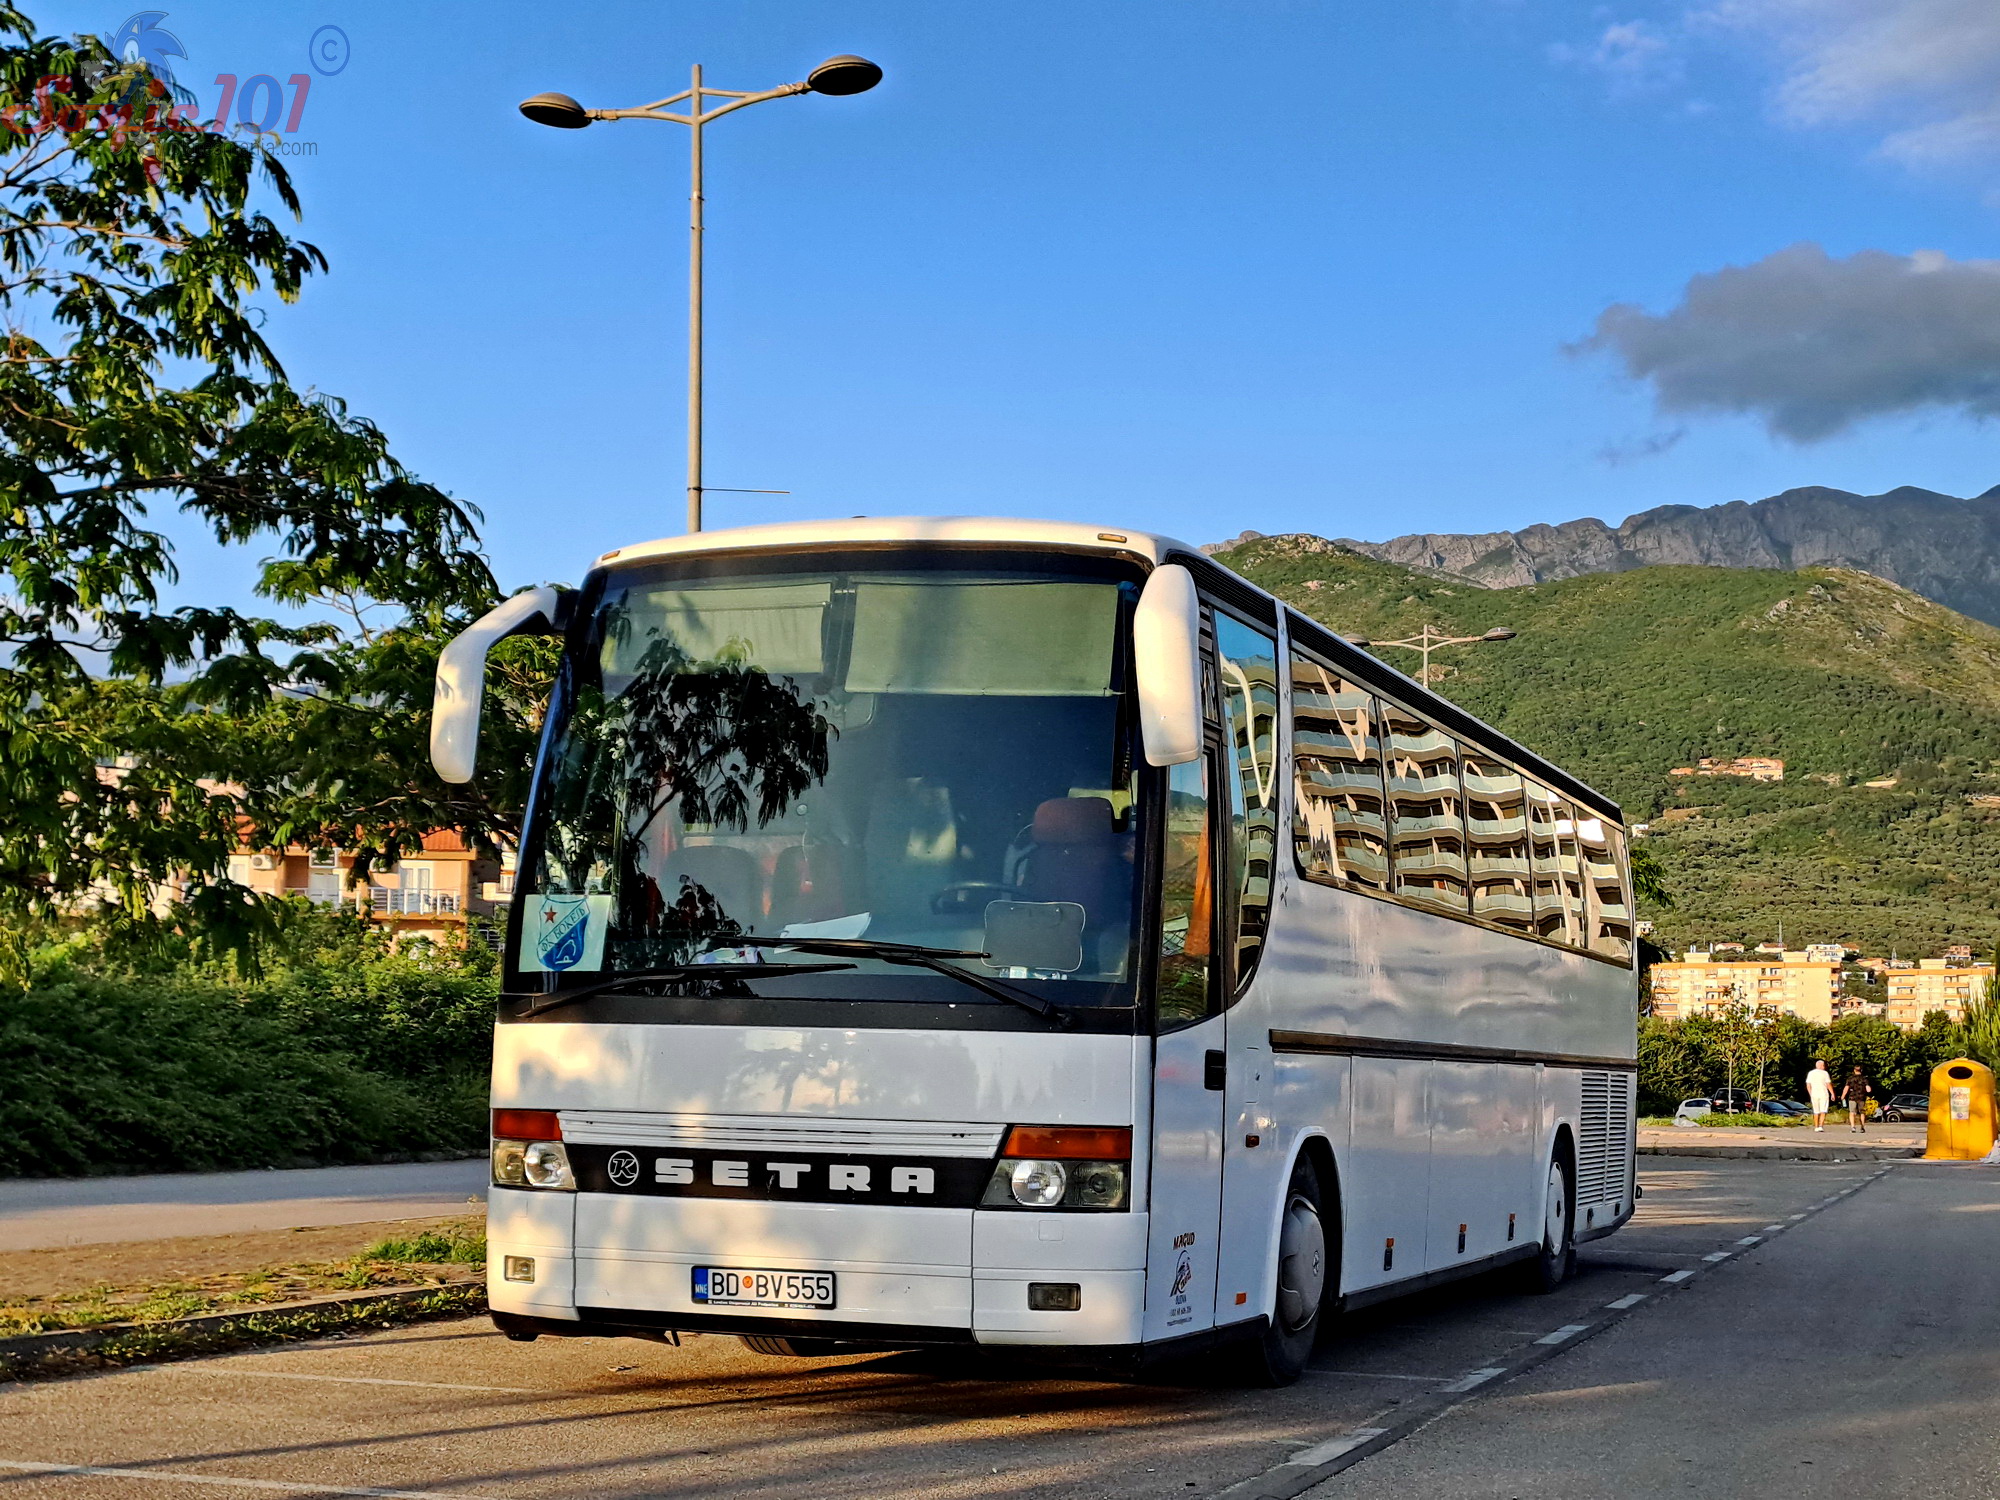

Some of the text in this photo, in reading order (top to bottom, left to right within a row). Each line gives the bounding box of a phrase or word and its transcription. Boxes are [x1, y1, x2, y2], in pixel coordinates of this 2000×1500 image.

[655, 1158, 934, 1194] SETRA
[695, 1272, 830, 1300] MNE BD BV555
